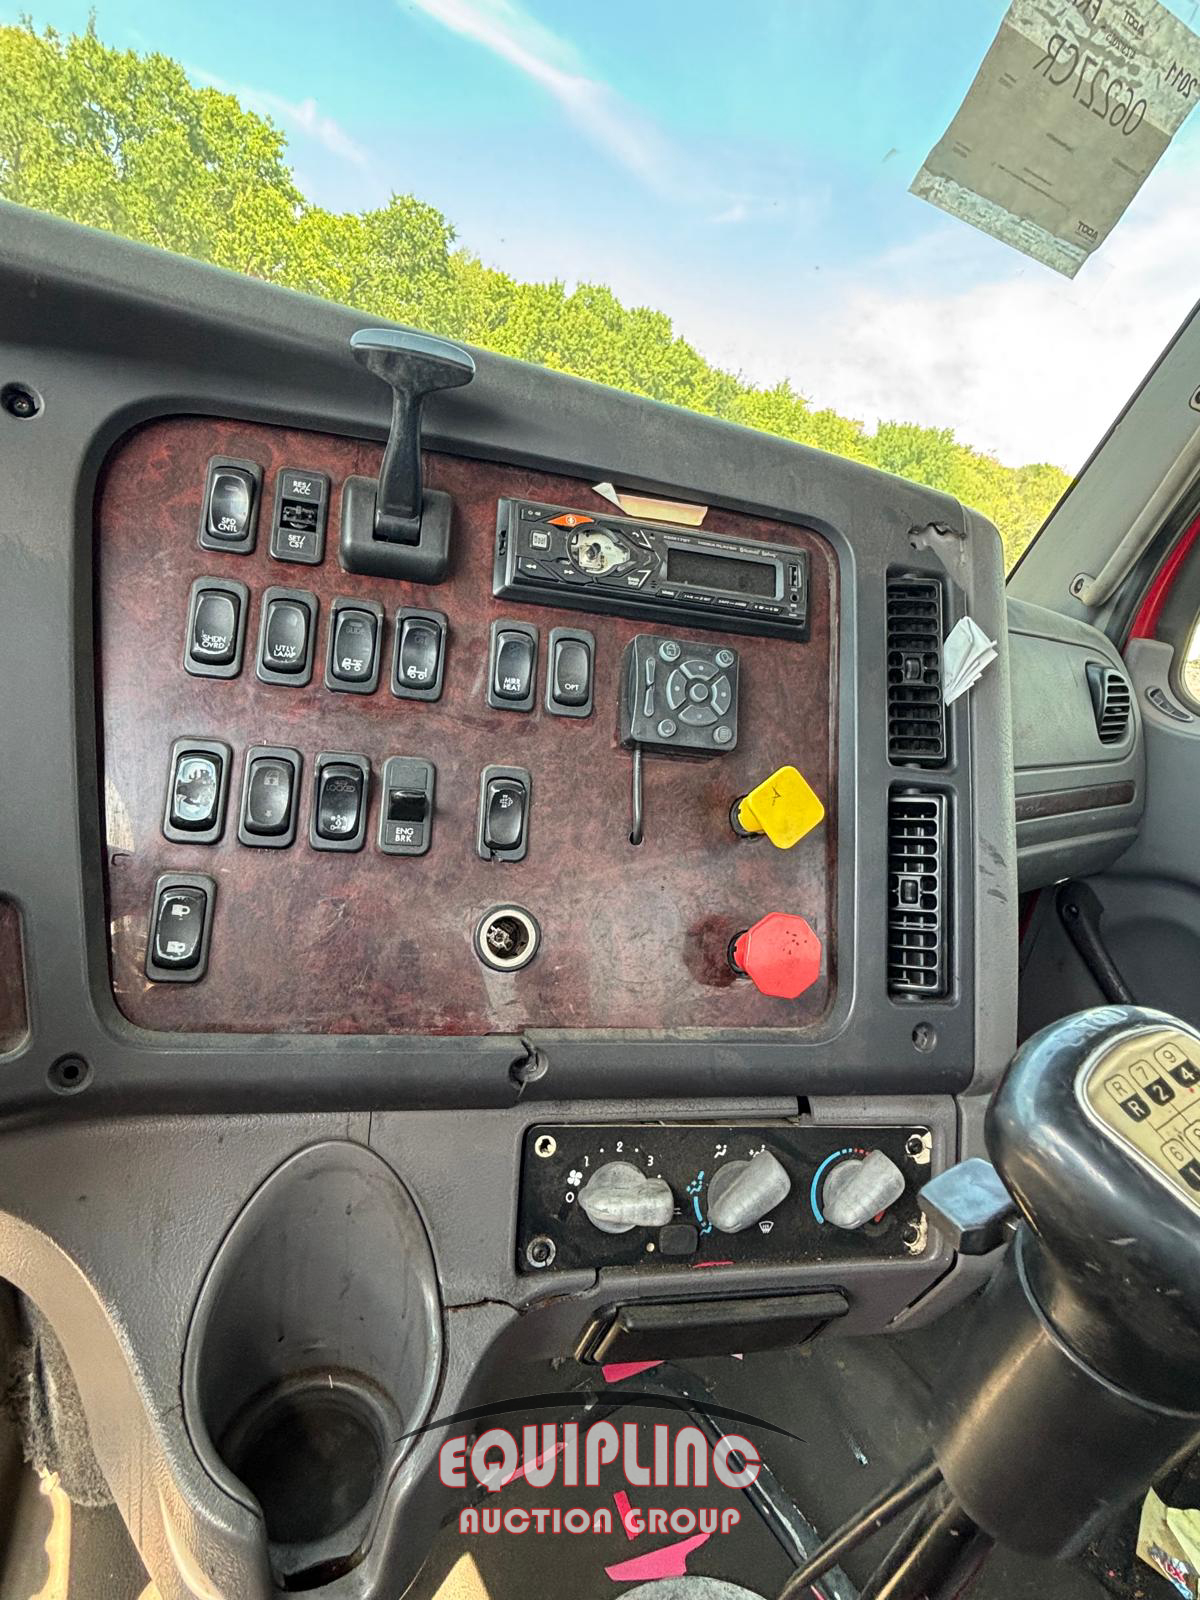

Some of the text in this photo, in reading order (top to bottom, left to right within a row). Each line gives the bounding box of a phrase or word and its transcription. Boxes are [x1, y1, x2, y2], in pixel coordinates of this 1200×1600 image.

[292, 487, 311, 495] ACC
[221, 516, 237, 525] SPD
[217, 523, 237, 533] CNTL
[288, 534, 306, 543] SET/
[289, 541, 304, 549] CST
[202, 633, 226, 643] SHDN
[202, 640, 225, 649] OVRD
[275, 644, 296, 653] UTLY
[273, 649, 296, 658] LAMP
[503, 683, 520, 691] HEAT
[564, 683, 579, 691] OPT
[395, 827, 414, 836] ENG
[394, 834, 412, 843] BRK
[1162, 1050, 1177, 1063] 9
[1135, 1066, 1149, 1081] 7
[1180, 1066, 1196, 1080] 4
[1112, 1081, 1129, 1097] R
[1152, 1085, 1170, 1101] 2
[1127, 1100, 1146, 1117] R
[616, 1140, 624, 1153] 2
[1169, 1146, 1184, 1162] 6
[584, 1155, 590, 1168] 1
[647, 1155, 654, 1167] 3
[565, 1191, 575, 1203] 0
